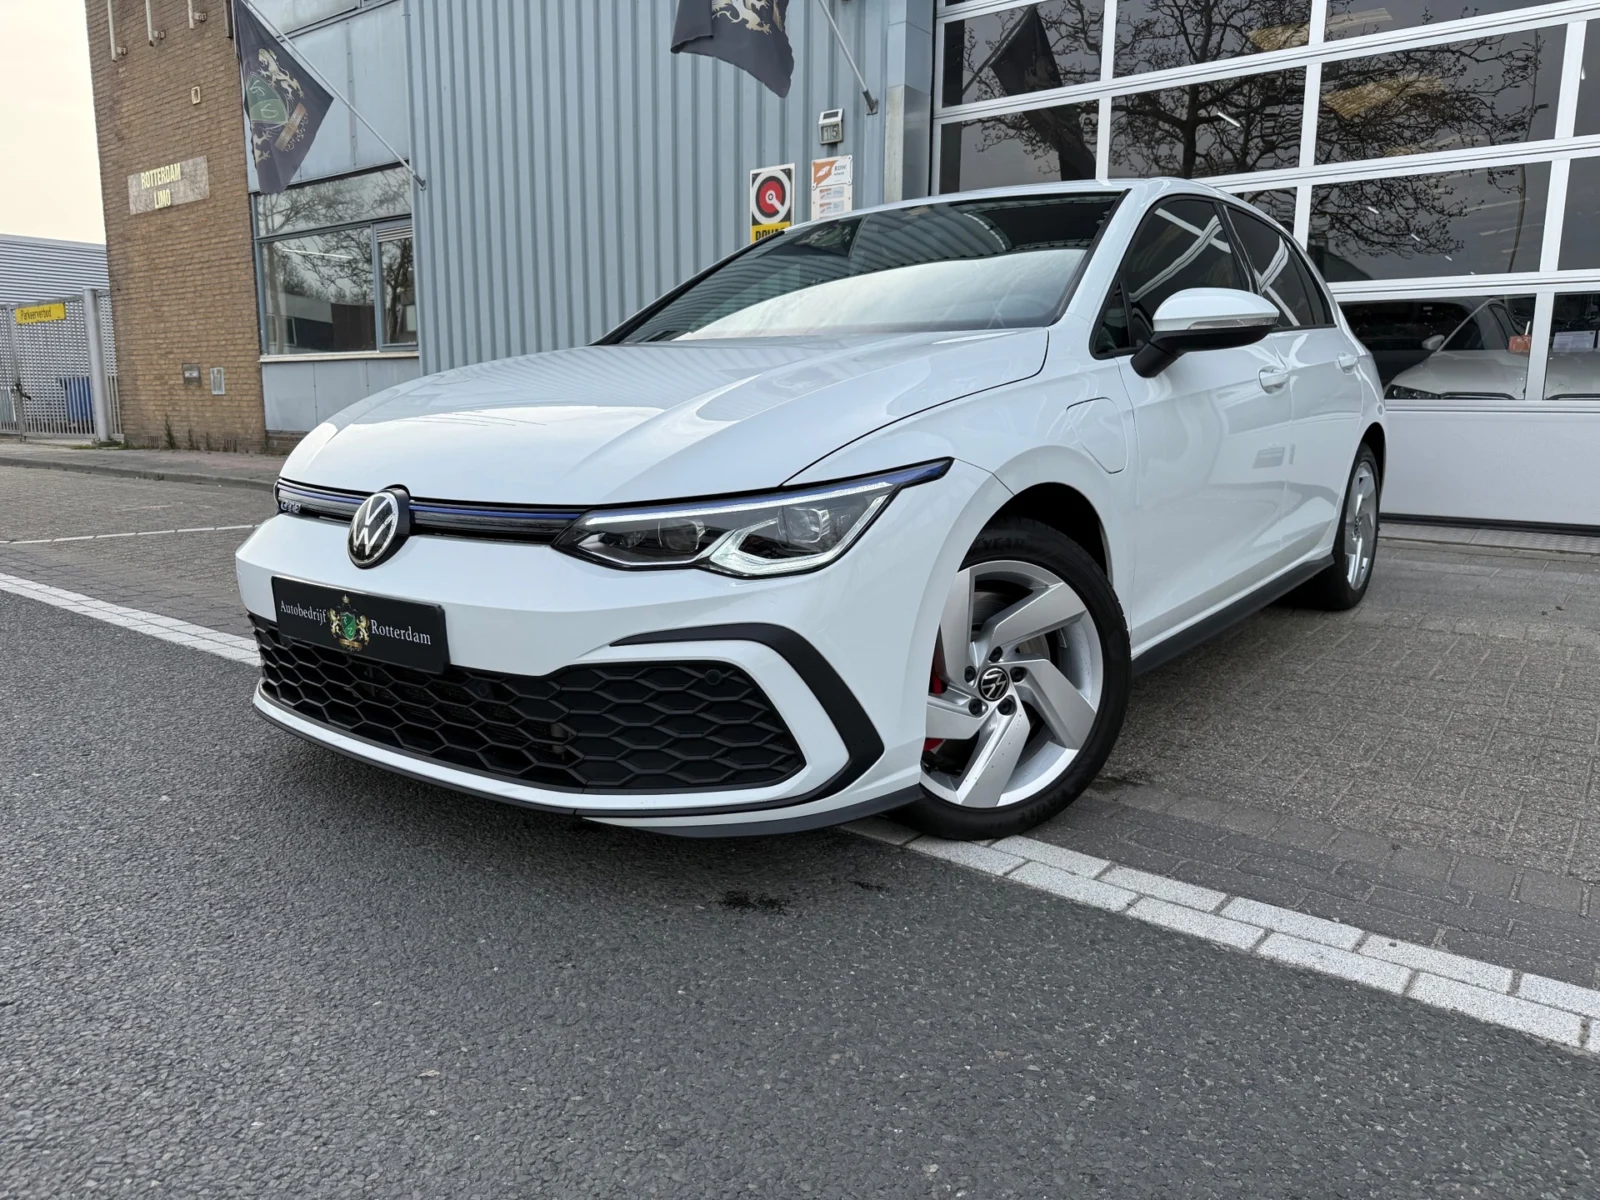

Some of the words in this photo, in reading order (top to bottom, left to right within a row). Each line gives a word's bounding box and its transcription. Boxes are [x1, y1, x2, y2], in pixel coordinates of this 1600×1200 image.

[140, 162, 181, 190] ROTTERDAM
[154, 189, 171, 209] LIMO
[280, 600, 327, 625] Autobedrijf
[371, 619, 431, 645] Rotterdam
